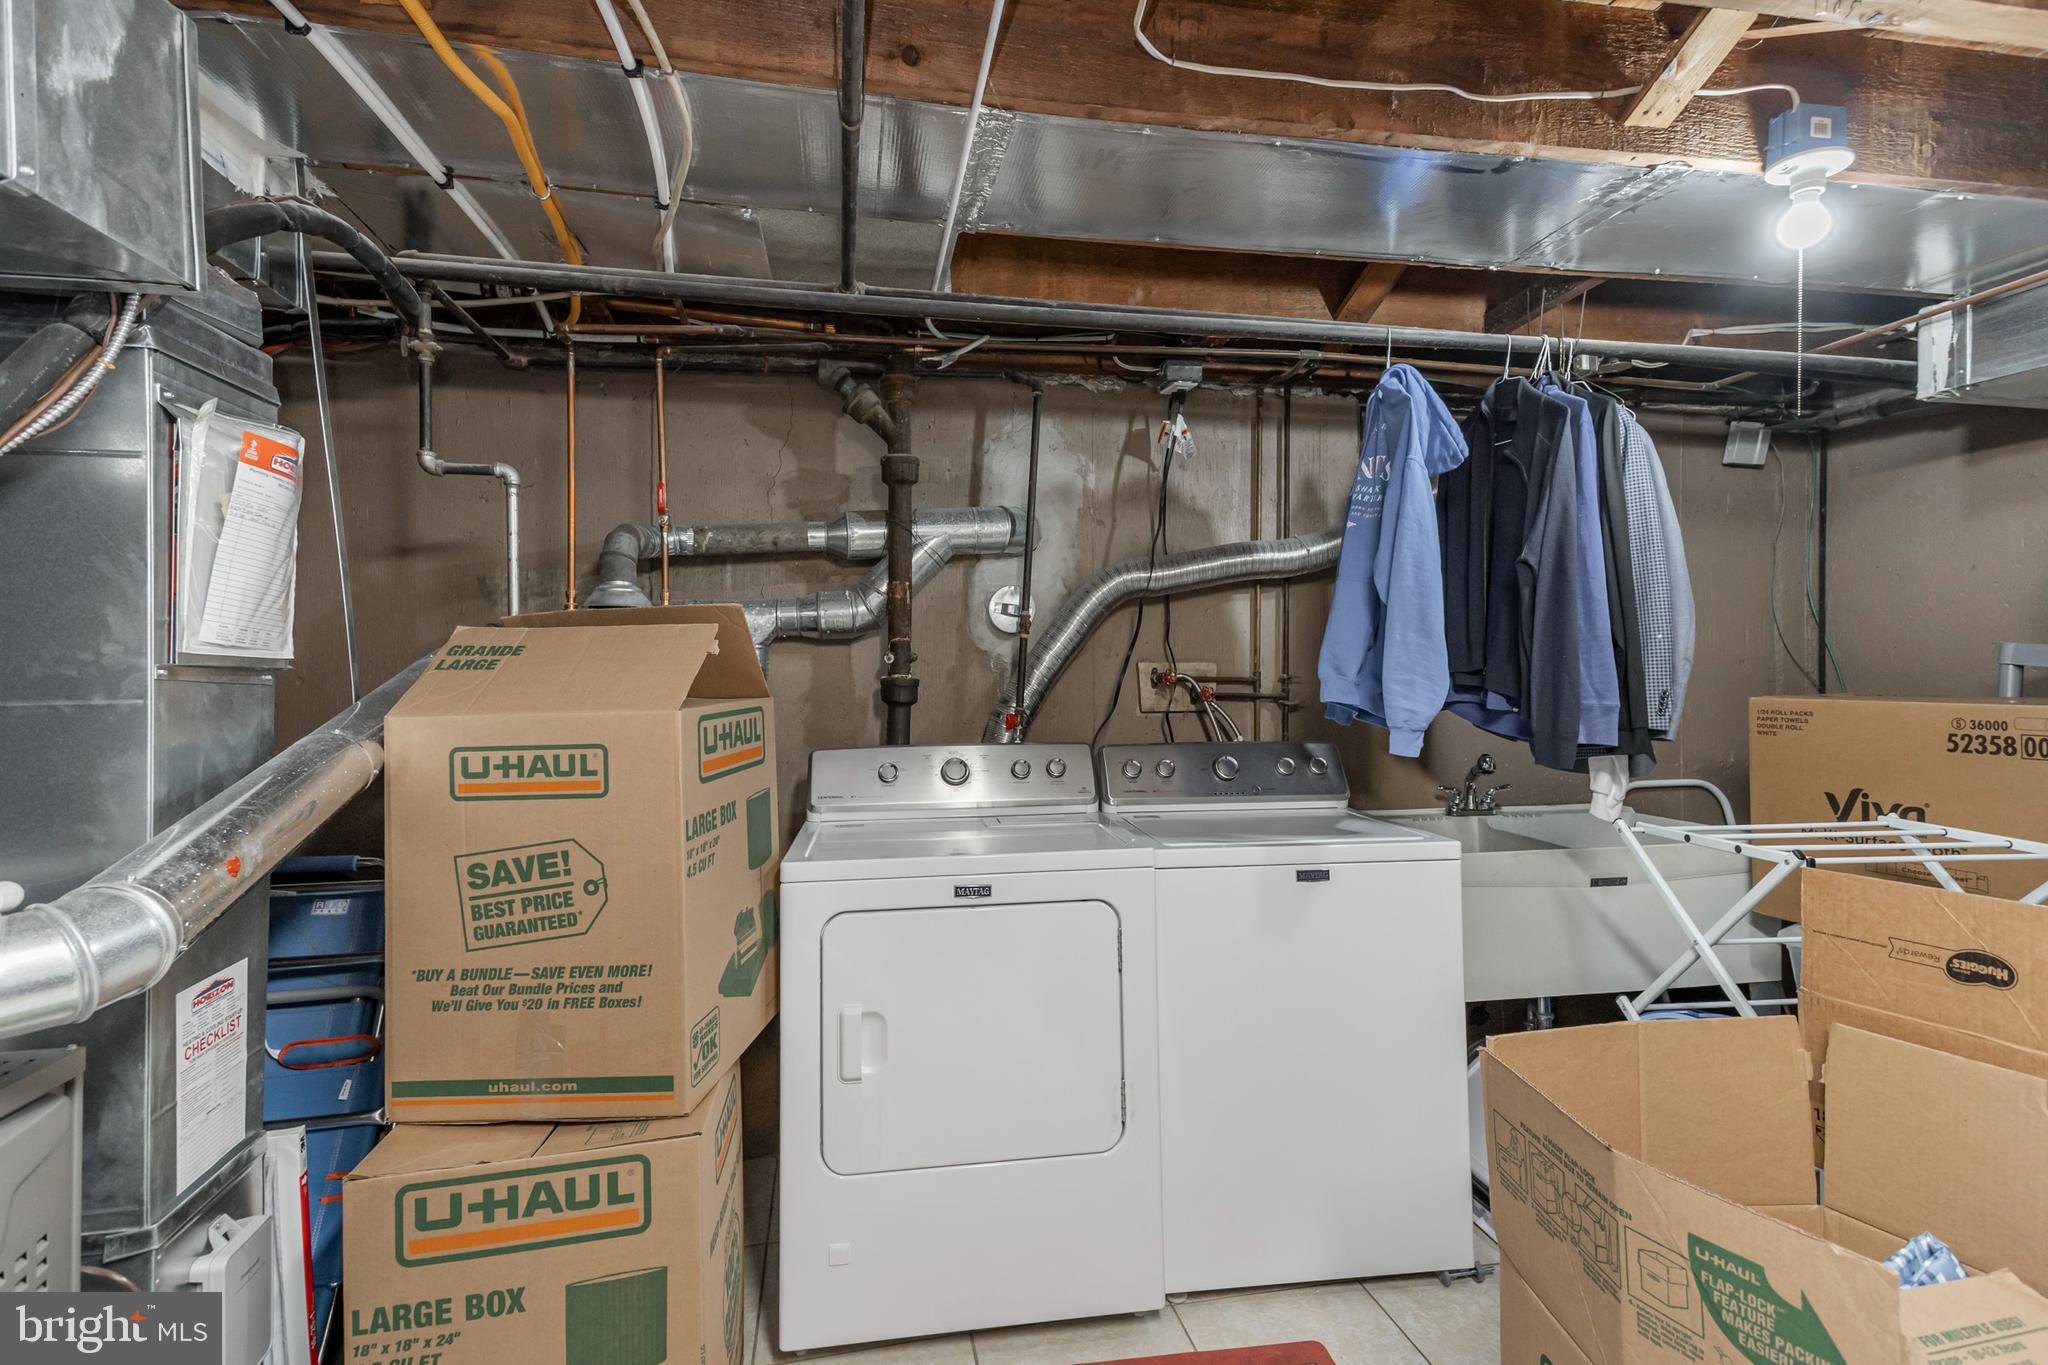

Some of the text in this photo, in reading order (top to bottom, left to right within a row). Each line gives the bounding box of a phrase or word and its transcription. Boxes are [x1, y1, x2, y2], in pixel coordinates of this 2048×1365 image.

[446, 645, 526, 657] GRANDE
[434, 659, 501, 671] LARGE
[703, 717, 761, 755] U-HAUL
[1969, 719, 2008, 731] 36000
[1947, 733, 2017, 757] 52358
[460, 753, 599, 779] U-HAUL
[685, 800, 737, 842] LARGE BOX
[466, 850, 572, 890] SAVE!
[687, 852, 715, 878] 4.5 CU FT
[1298, 871, 1329, 880] MAYTAG
[956, 886, 990, 898] MAYTAG
[471, 891, 575, 921] BEST PRICE
[1896, 947, 1941, 963] Rewards
[447, 969, 456, 981] A
[569, 966, 606, 979] EVEN
[607, 964, 653, 978] MORE!
[193, 981, 234, 1009] HORIZON
[450, 981, 623, 997] Beat Our Bundle Prices and
[431, 996, 642, 1012] We'll Give You $20 in FREE Boxes!
[184, 1015, 241, 1060] CHECKLIST
[702, 1032, 718, 1061] OK
[488, 1082, 577, 1094] uhaul.com
[414, 1171, 635, 1232] U-HAUL
[1609, 1200, 1632, 1221] OPEN
[1695, 1246, 1761, 1287] U-HAUL
[351, 1298, 453, 1337] LARGE
[465, 1286, 526, 1321] BOX
[1713, 1291, 1775, 1332] FEATURE
[1721, 1309, 1771, 1345] MAKES
[353, 1331, 461, 1358] 18" x 18" x 24"
